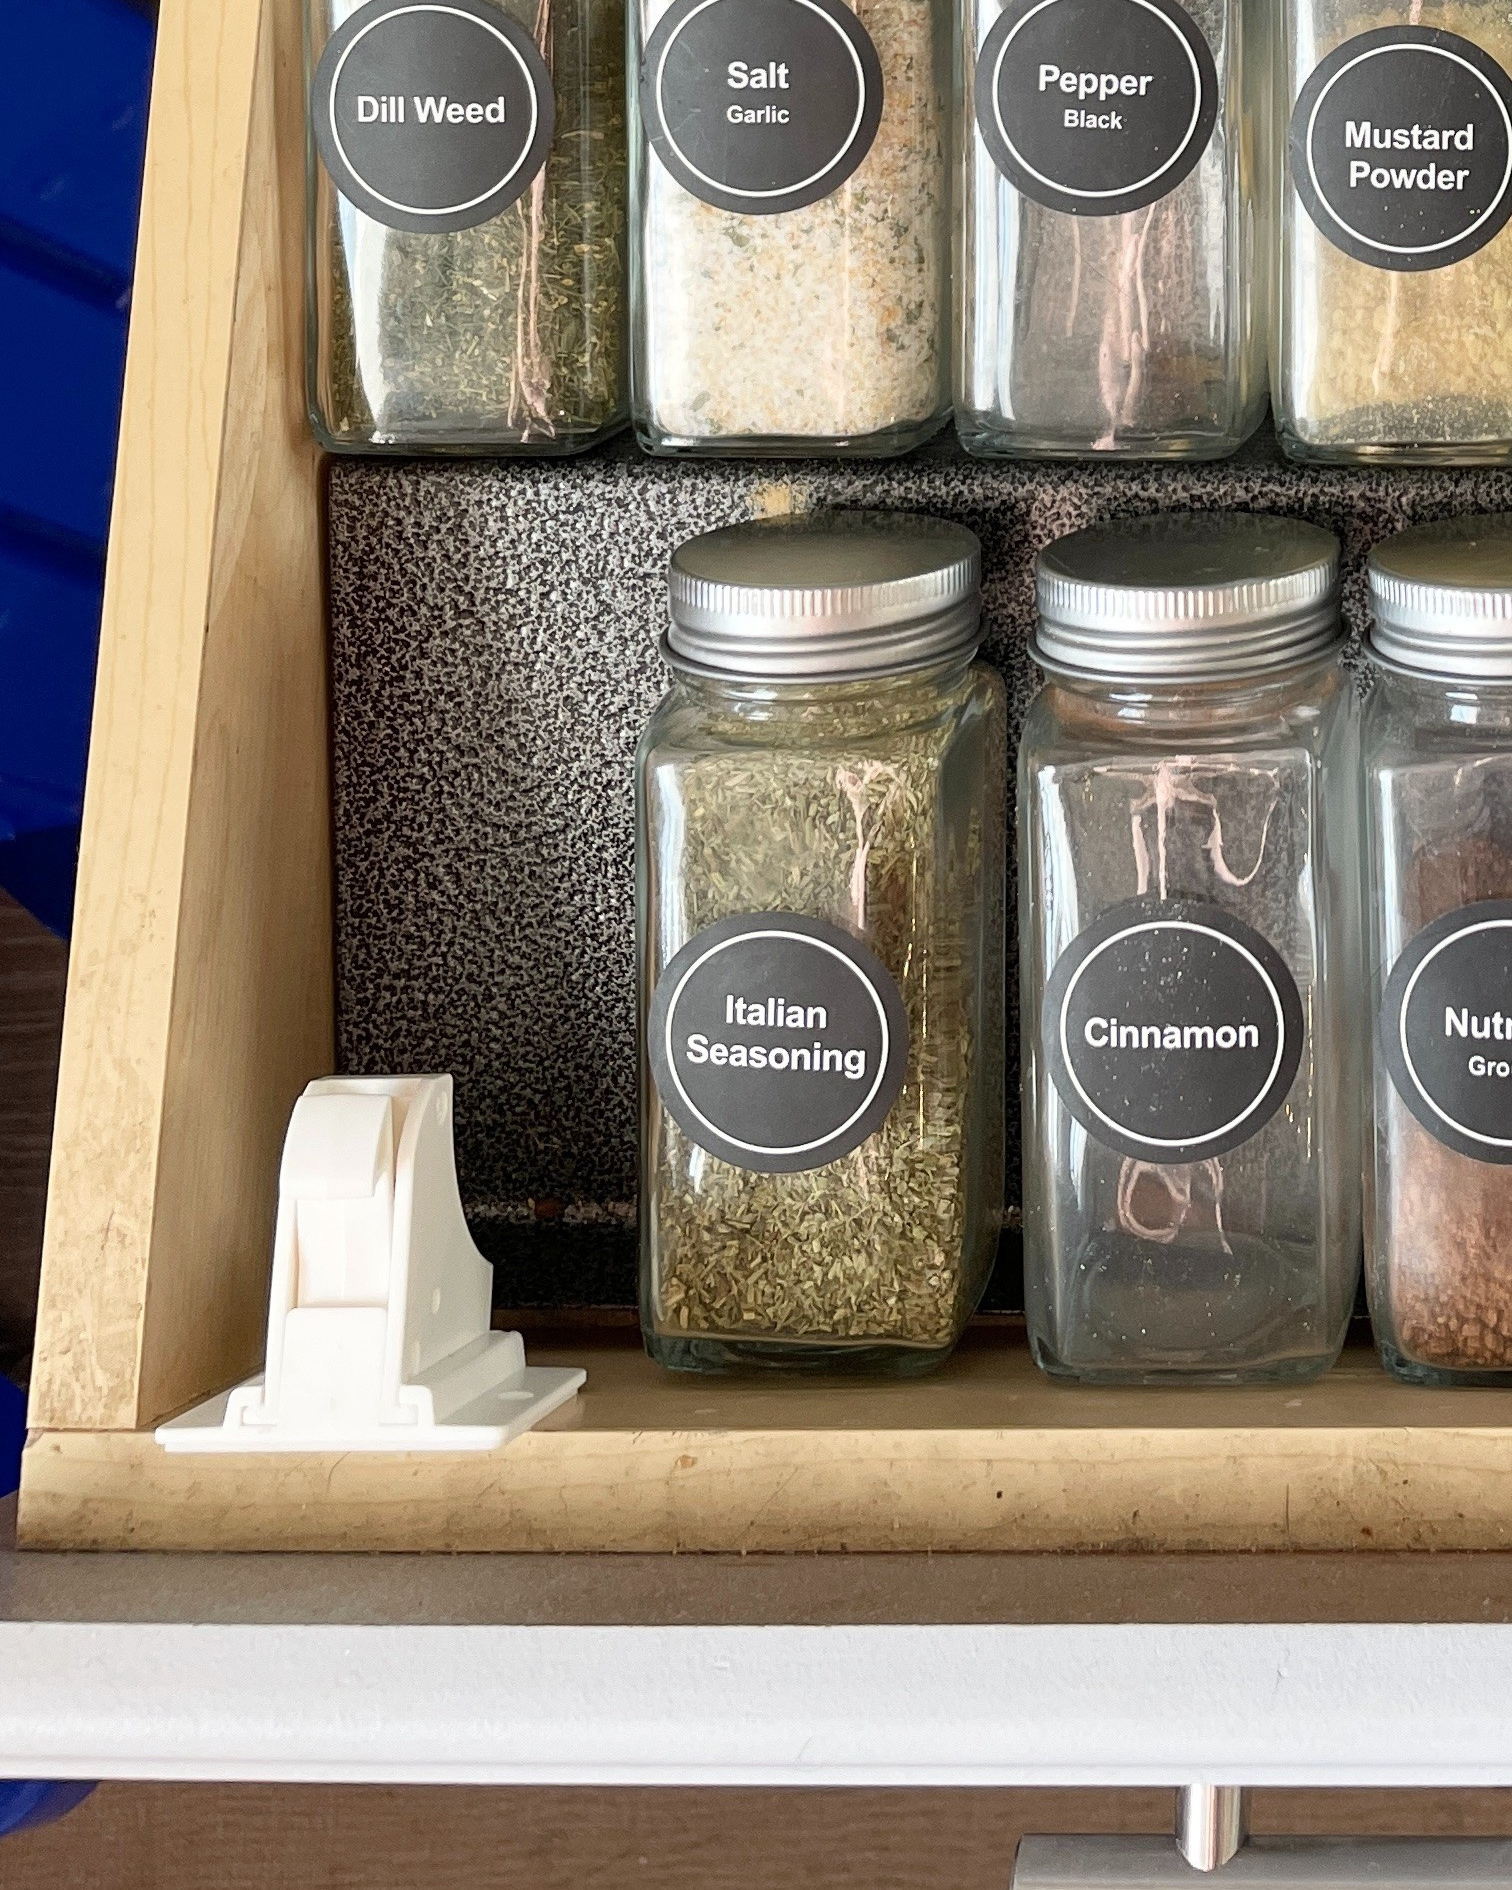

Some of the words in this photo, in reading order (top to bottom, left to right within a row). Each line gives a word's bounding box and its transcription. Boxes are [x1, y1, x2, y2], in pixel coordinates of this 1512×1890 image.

[727, 61, 790, 89] Salt
[1038, 64, 1153, 101] Pepper
[357, 95, 405, 124] Dill
[413, 95, 505, 125] Weed
[726, 104, 790, 124] Garlic
[1063, 109, 1123, 130] Black
[1345, 120, 1474, 151] Mustard
[1349, 160, 1470, 190] Powder
[725, 994, 827, 1029] Italian
[1084, 1017, 1259, 1050] Cinnamon
[686, 1033, 866, 1080] Seasoning
